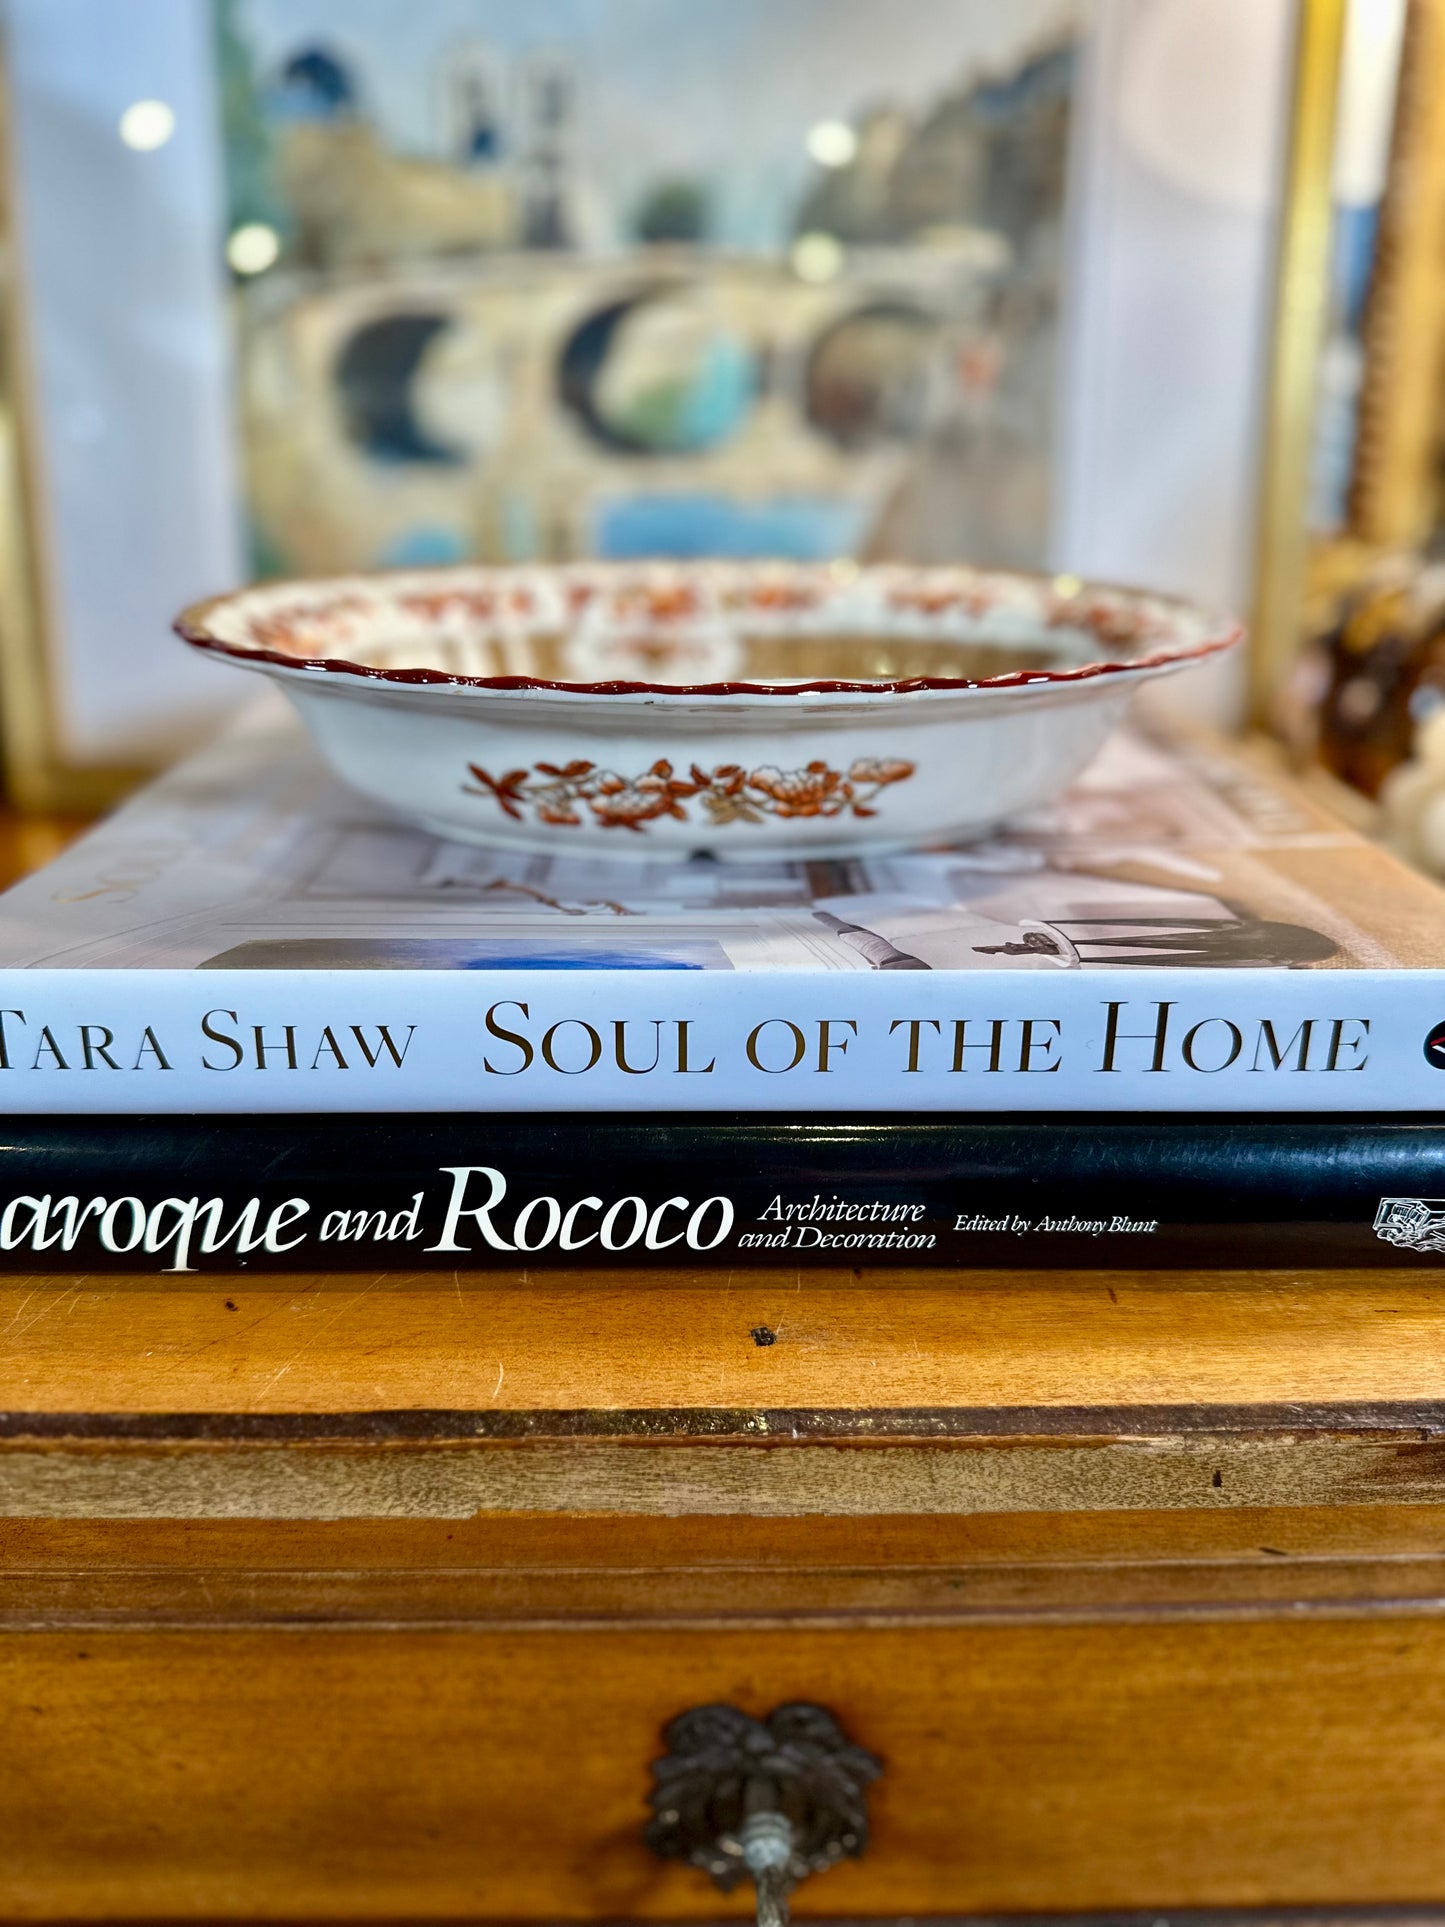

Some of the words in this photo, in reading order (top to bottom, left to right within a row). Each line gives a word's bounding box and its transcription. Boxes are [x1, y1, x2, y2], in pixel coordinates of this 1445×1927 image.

[201, 1009, 418, 1072] SHAW
[483, 1000, 716, 1076] SOUL
[745, 1019, 858, 1074] OF
[888, 1019, 1063, 1073] THE
[1093, 1001, 1370, 1073] HOME
[319, 1191, 425, 1242] and
[423, 1166, 735, 1252] Rococo
[756, 1194, 926, 1222] Architecture
[953, 1214, 1010, 1231] Edited
[1010, 1214, 1031, 1236] by
[1033, 1215, 1107, 1237] Anthony
[1107, 1215, 1159, 1233] Blunt
[737, 1225, 791, 1248] and
[791, 1226, 937, 1249] Decoration
